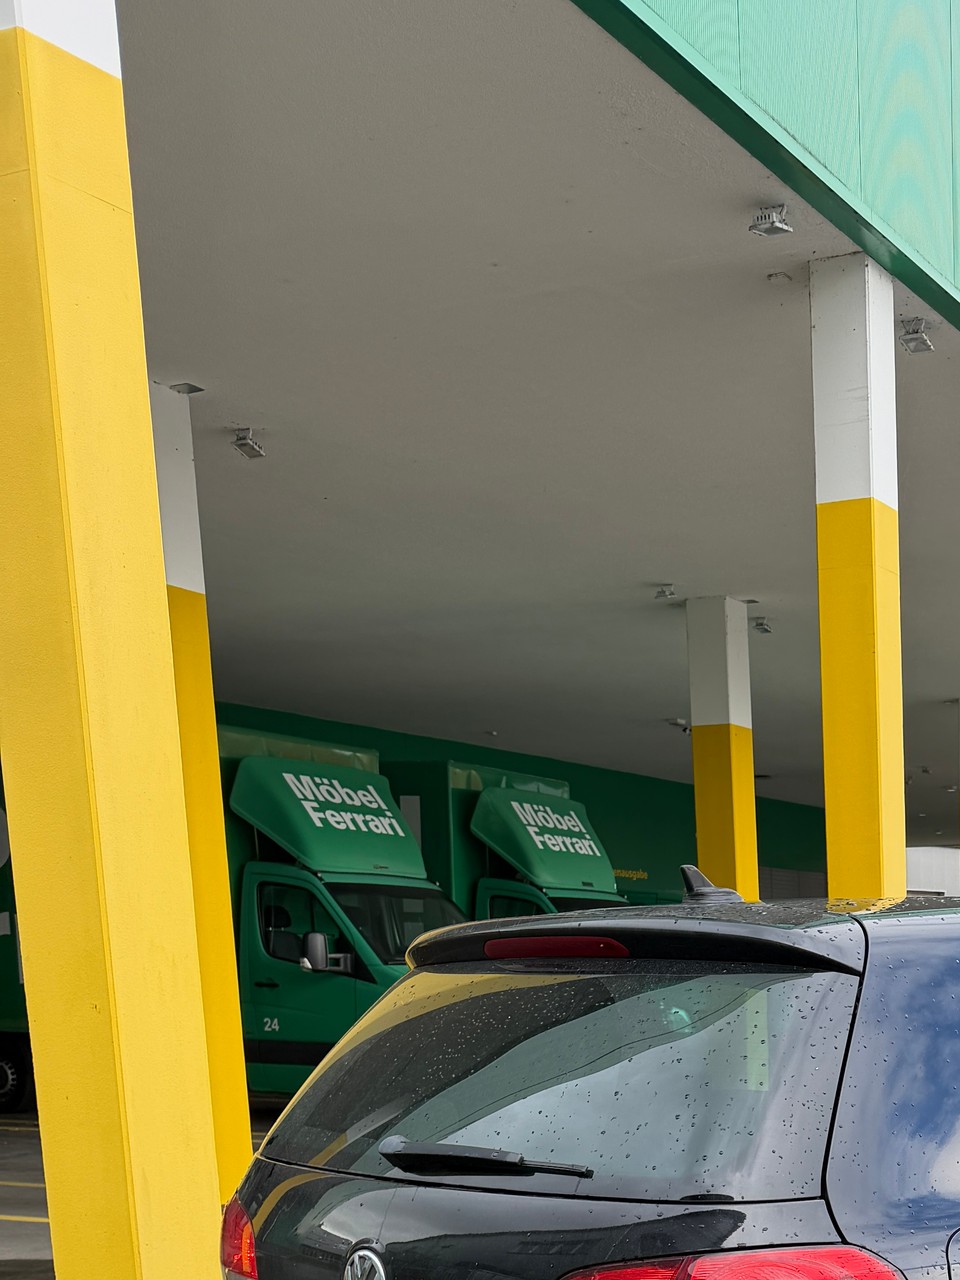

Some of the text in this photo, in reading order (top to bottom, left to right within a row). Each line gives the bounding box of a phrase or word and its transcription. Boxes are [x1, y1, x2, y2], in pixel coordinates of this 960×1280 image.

[282, 772, 388, 810] Möbel
[300, 800, 405, 837] Ferrari
[511, 801, 587, 833] Möbel
[526, 825, 601, 857] Ferrari
[263, 1017, 280, 1031] 24
